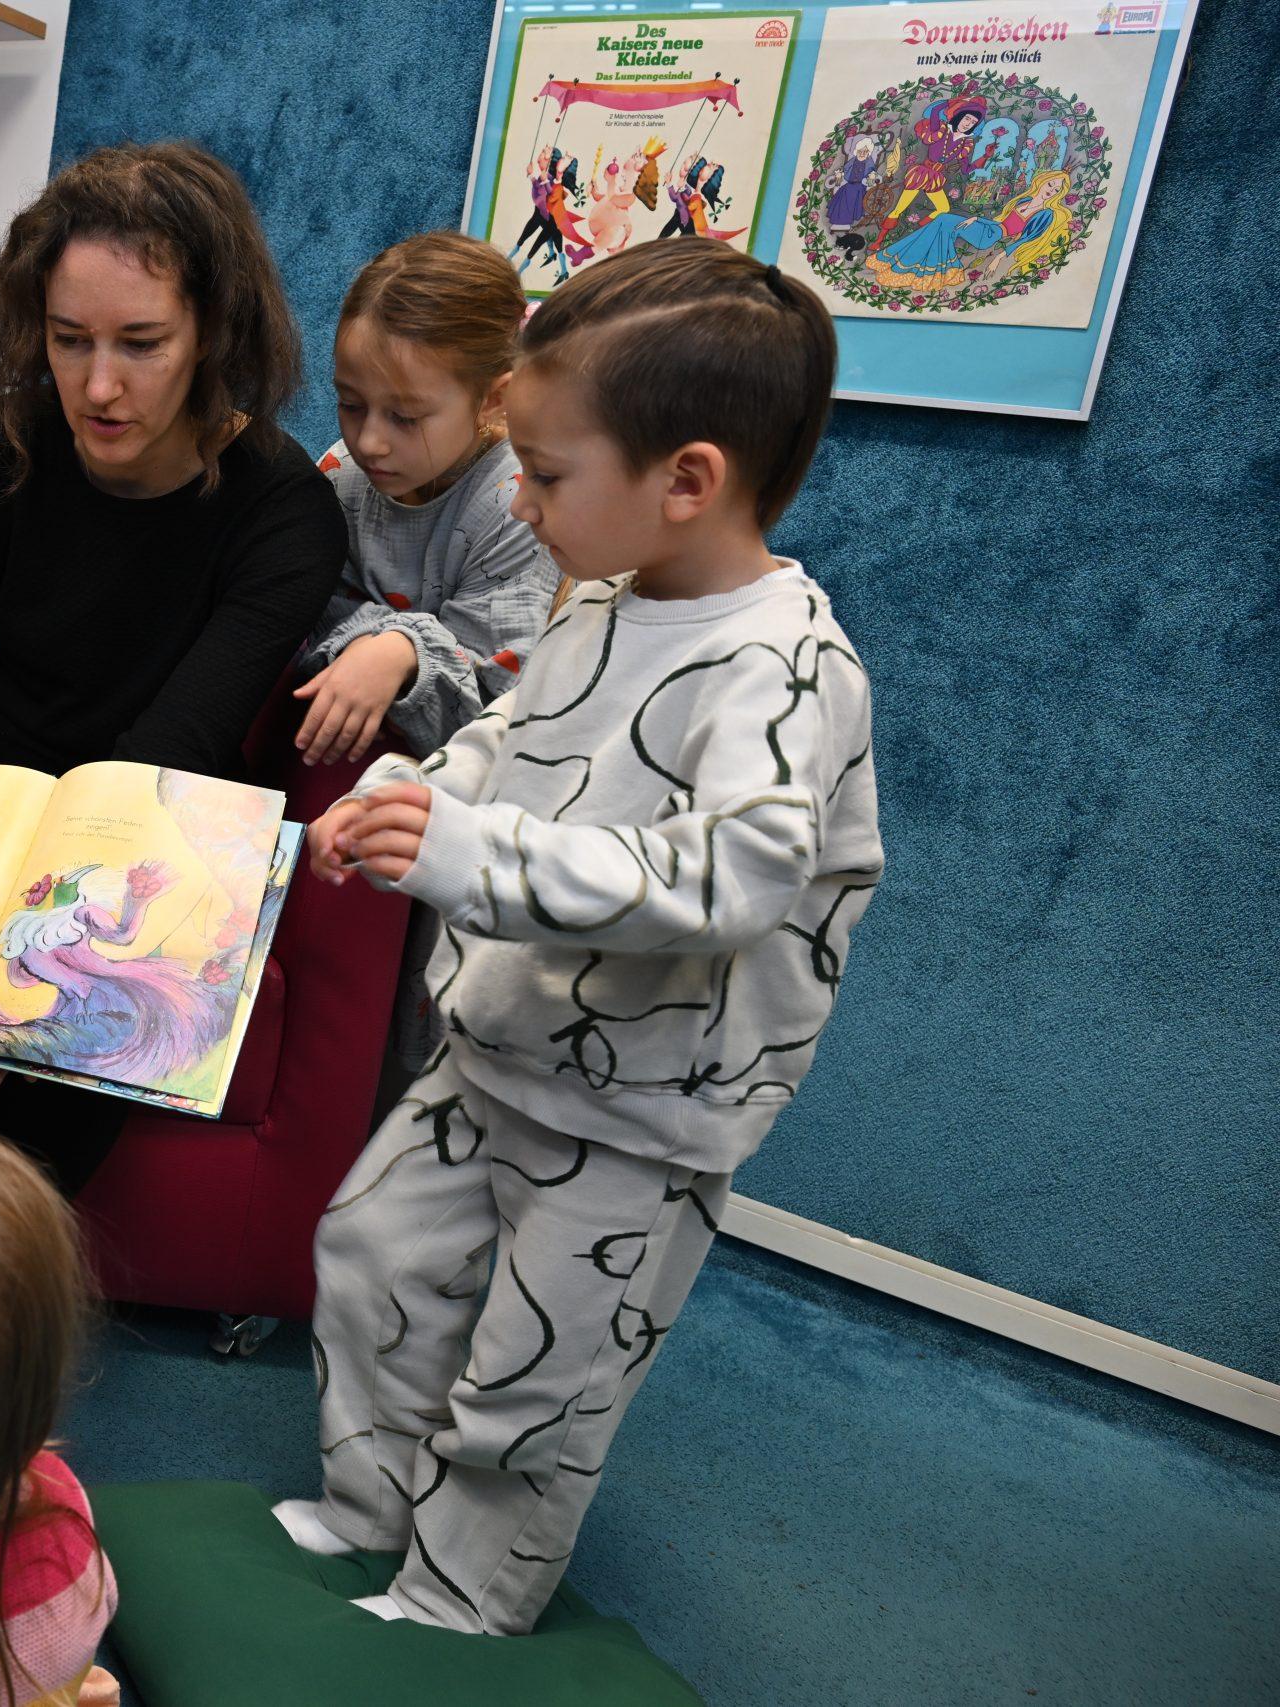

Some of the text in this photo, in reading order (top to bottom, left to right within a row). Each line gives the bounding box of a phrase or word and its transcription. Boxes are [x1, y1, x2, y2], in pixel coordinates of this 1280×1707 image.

[1122, 10, 1154, 23] EUROPA
[635, 23, 667, 39] Des
[900, 14, 1069, 48] Dornröschen
[596, 36, 704, 52] Kaisers neue
[616, 52, 679, 67] Kleider
[916, 49, 1042, 66] und Hans im Glück
[595, 71, 693, 83] Das Lumpengesindel
[615, 112, 664, 121] Märchenhörspiele
